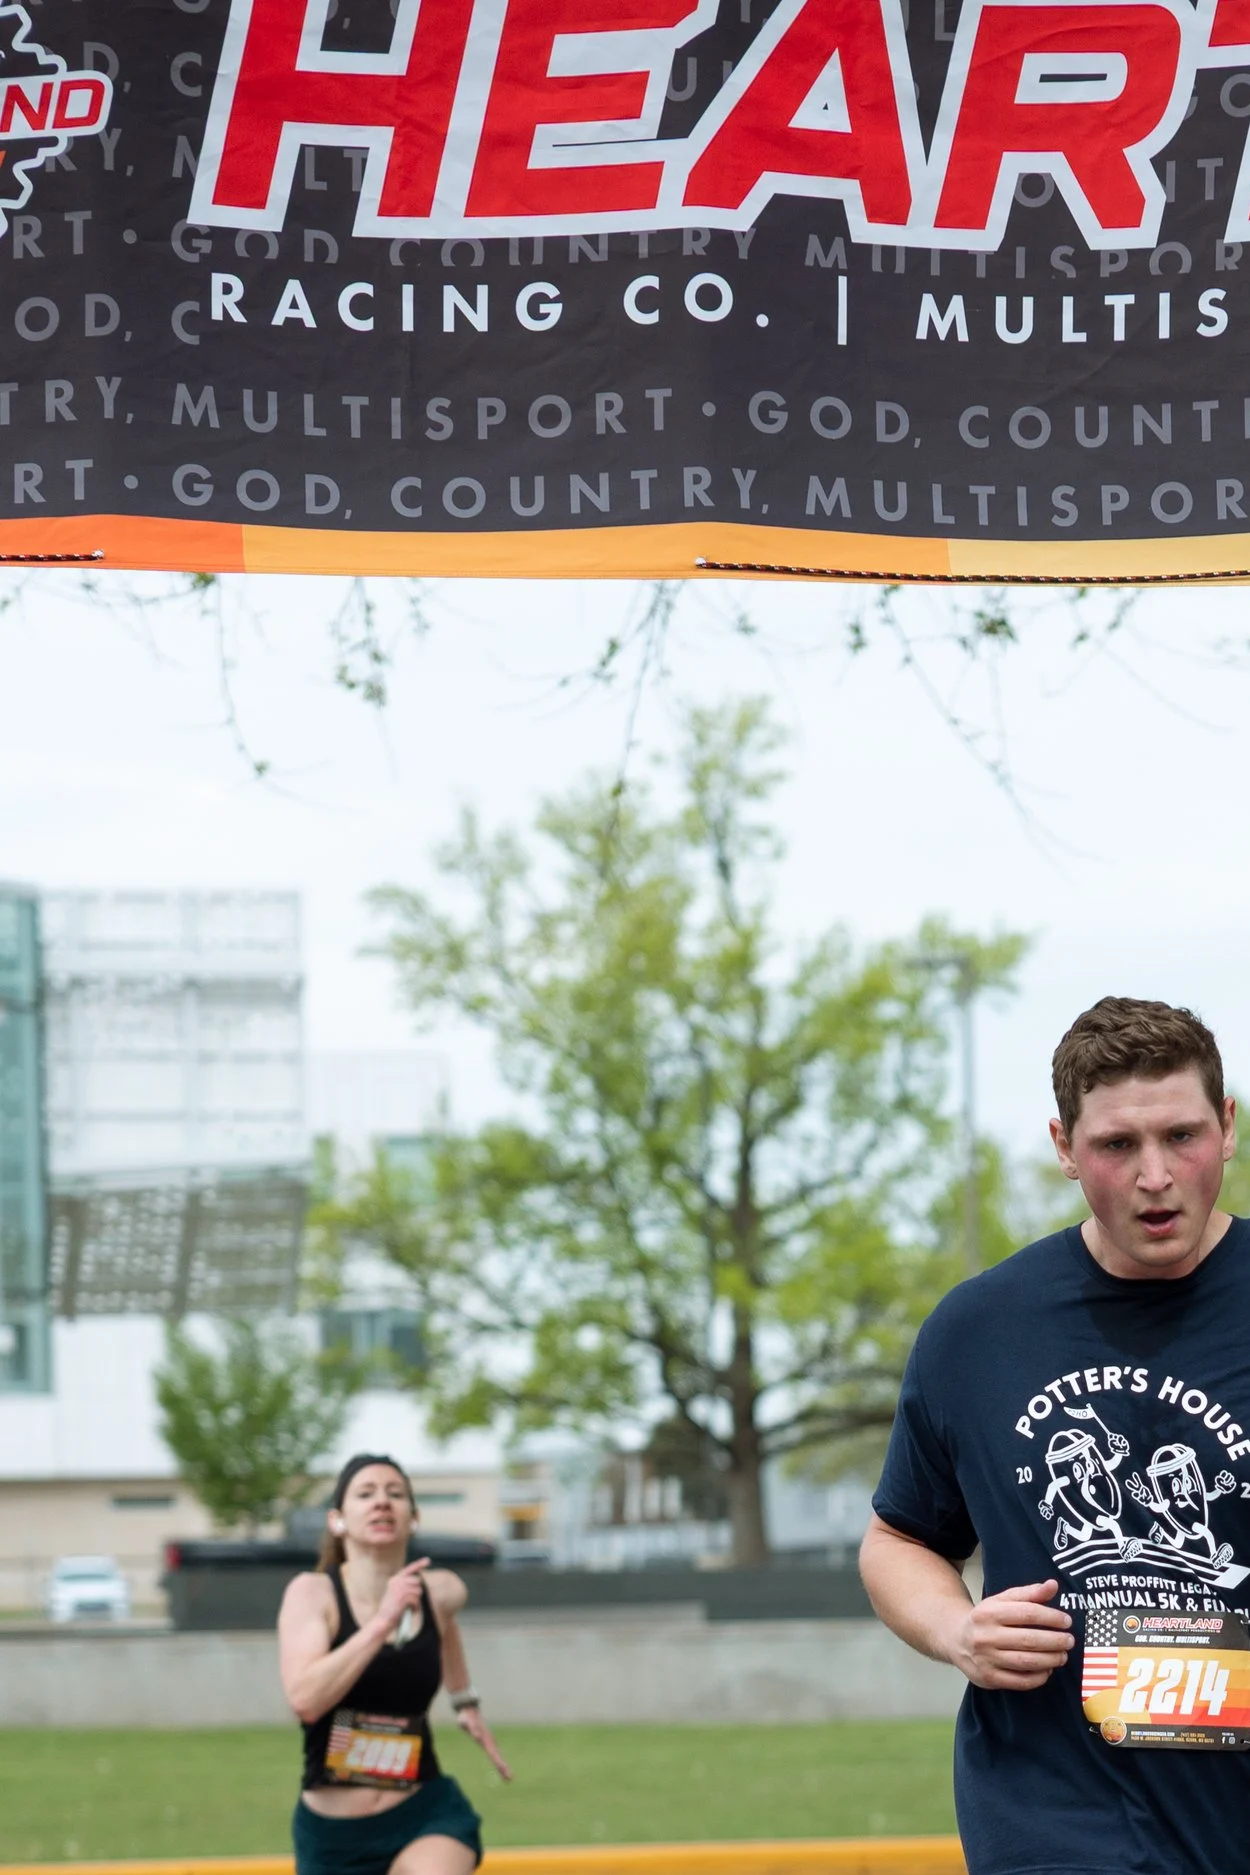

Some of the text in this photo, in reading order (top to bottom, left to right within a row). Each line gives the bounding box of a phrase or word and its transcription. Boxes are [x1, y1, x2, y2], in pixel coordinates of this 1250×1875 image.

[211, 272, 563, 333] RACING
[623, 272, 769, 328] CO.
[171, 382, 673, 442] MULTISPORT
[747, 390, 922, 449] GOD,
[171, 462, 353, 522] GOD,
[389, 465, 771, 519] COUNTRY,
[1015, 1366, 1148, 1439] POTTER'S
[1015, 1466, 1033, 1484] 20
[1085, 1574, 1119, 1589] STEVE
[1121, 1575, 1176, 1592] PROFFITT
[1087, 1589, 1156, 1609] ANNUAL
[1158, 1592, 1181, 1610] 5K
[1186, 1597, 1199, 1612] &
[1142, 1616, 1223, 1630] HEARTLAND
[1118, 1657, 1230, 1717] 2214
